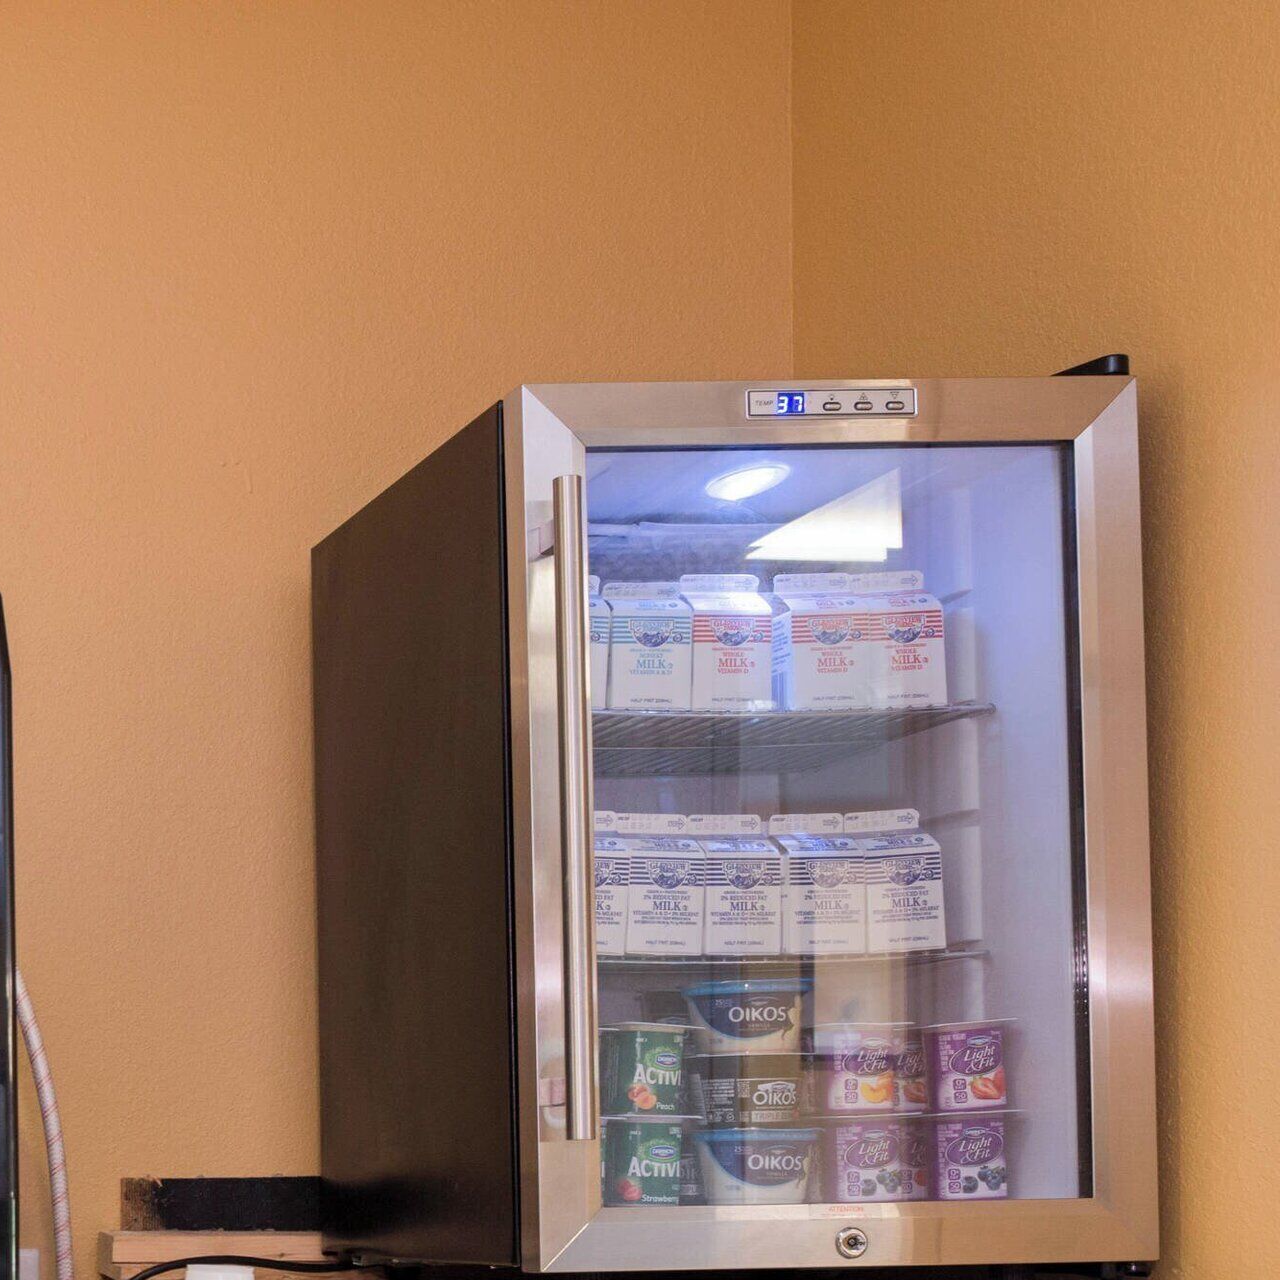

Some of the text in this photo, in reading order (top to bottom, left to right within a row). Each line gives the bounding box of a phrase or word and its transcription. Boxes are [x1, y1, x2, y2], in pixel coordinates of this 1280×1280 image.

[777, 396, 803, 413] 37
[636, 659, 666, 669] MILK
[718, 658, 748, 668] MILK
[817, 657, 848, 667] MILK
[891, 654, 921, 664] MILK
[653, 901, 681, 910] MILK
[731, 902, 759, 911] MILK
[815, 900, 842, 910] MILK
[892, 898, 920, 908] MILK
[728, 1007, 786, 1022] OIKOS
[857, 1046, 888, 1062] Light
[964, 1046, 996, 1063] Light
[871, 1060, 888, 1072] Fit
[979, 1057, 995, 1069] Fit
[633, 1063, 681, 1086] ACTIVI
[752, 1091, 797, 1105] OIKOS
[656, 1101, 676, 1111] Peach
[858, 1140, 891, 1156] Light
[959, 1137, 992, 1153] Light
[873, 1151, 889, 1163] Fit
[974, 1149, 991, 1160] Fit
[627, 1156, 680, 1177] ACTIVI
[747, 1154, 802, 1170] OIKOS
